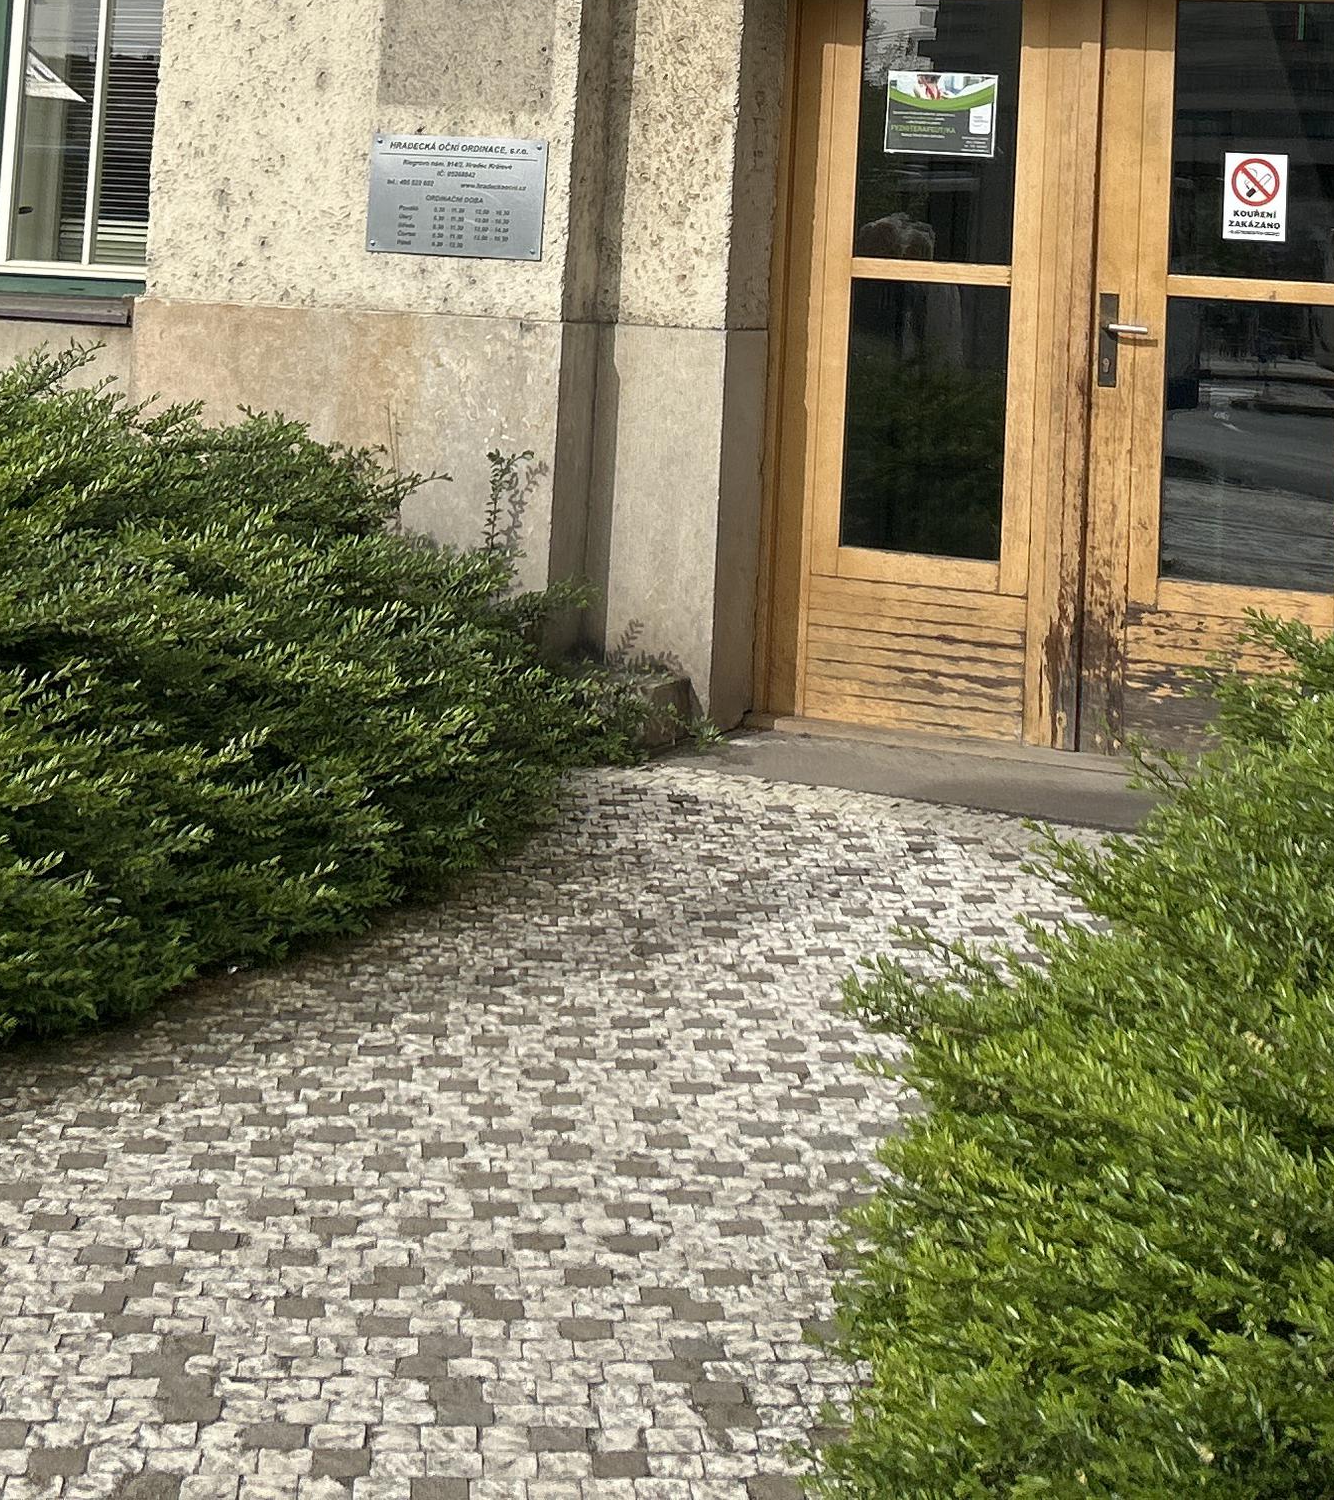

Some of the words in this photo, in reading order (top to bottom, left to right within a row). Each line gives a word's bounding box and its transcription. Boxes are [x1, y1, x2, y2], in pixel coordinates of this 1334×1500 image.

[390, 141, 436, 151] HRADECKÁ
[438, 142, 460, 151] OČNÍ
[1233, 209, 1276, 218] KOUŘENÍ
